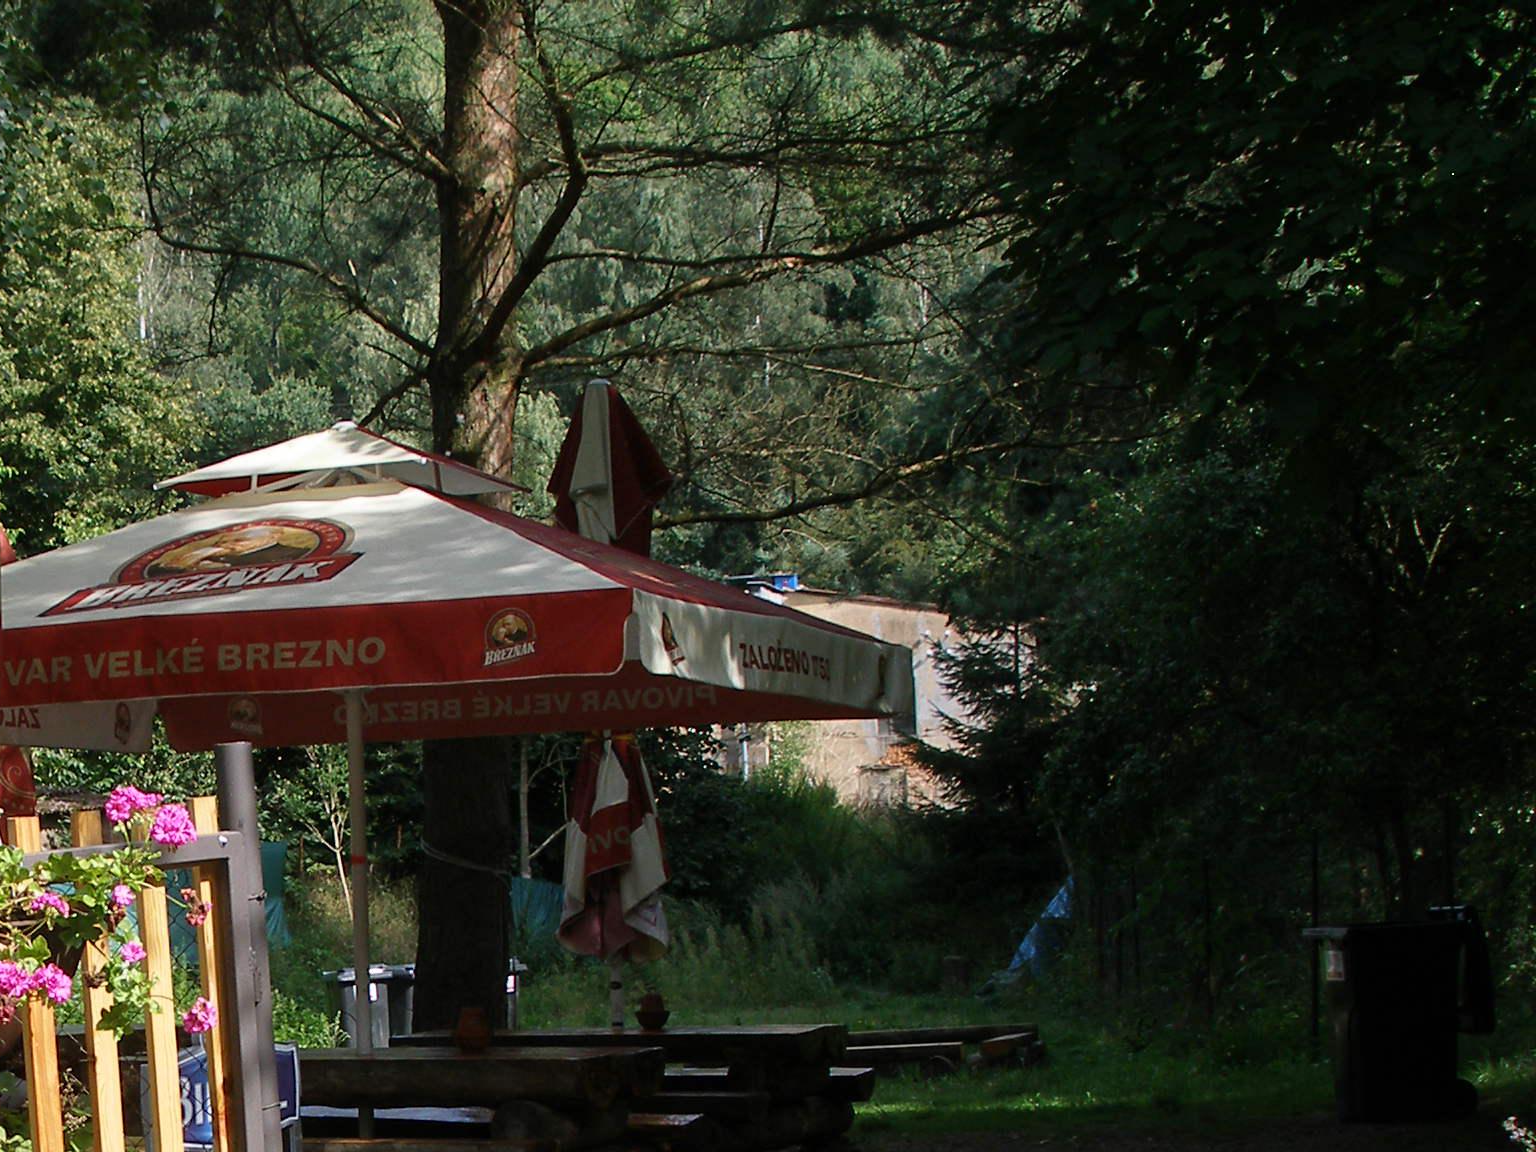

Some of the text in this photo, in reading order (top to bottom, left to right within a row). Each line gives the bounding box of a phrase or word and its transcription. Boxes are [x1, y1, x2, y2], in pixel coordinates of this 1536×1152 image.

[84, 638, 205, 679] VELKÉ
[218, 637, 386, 672] BREZNO
[739, 639, 809, 676] ZALOŽENO
